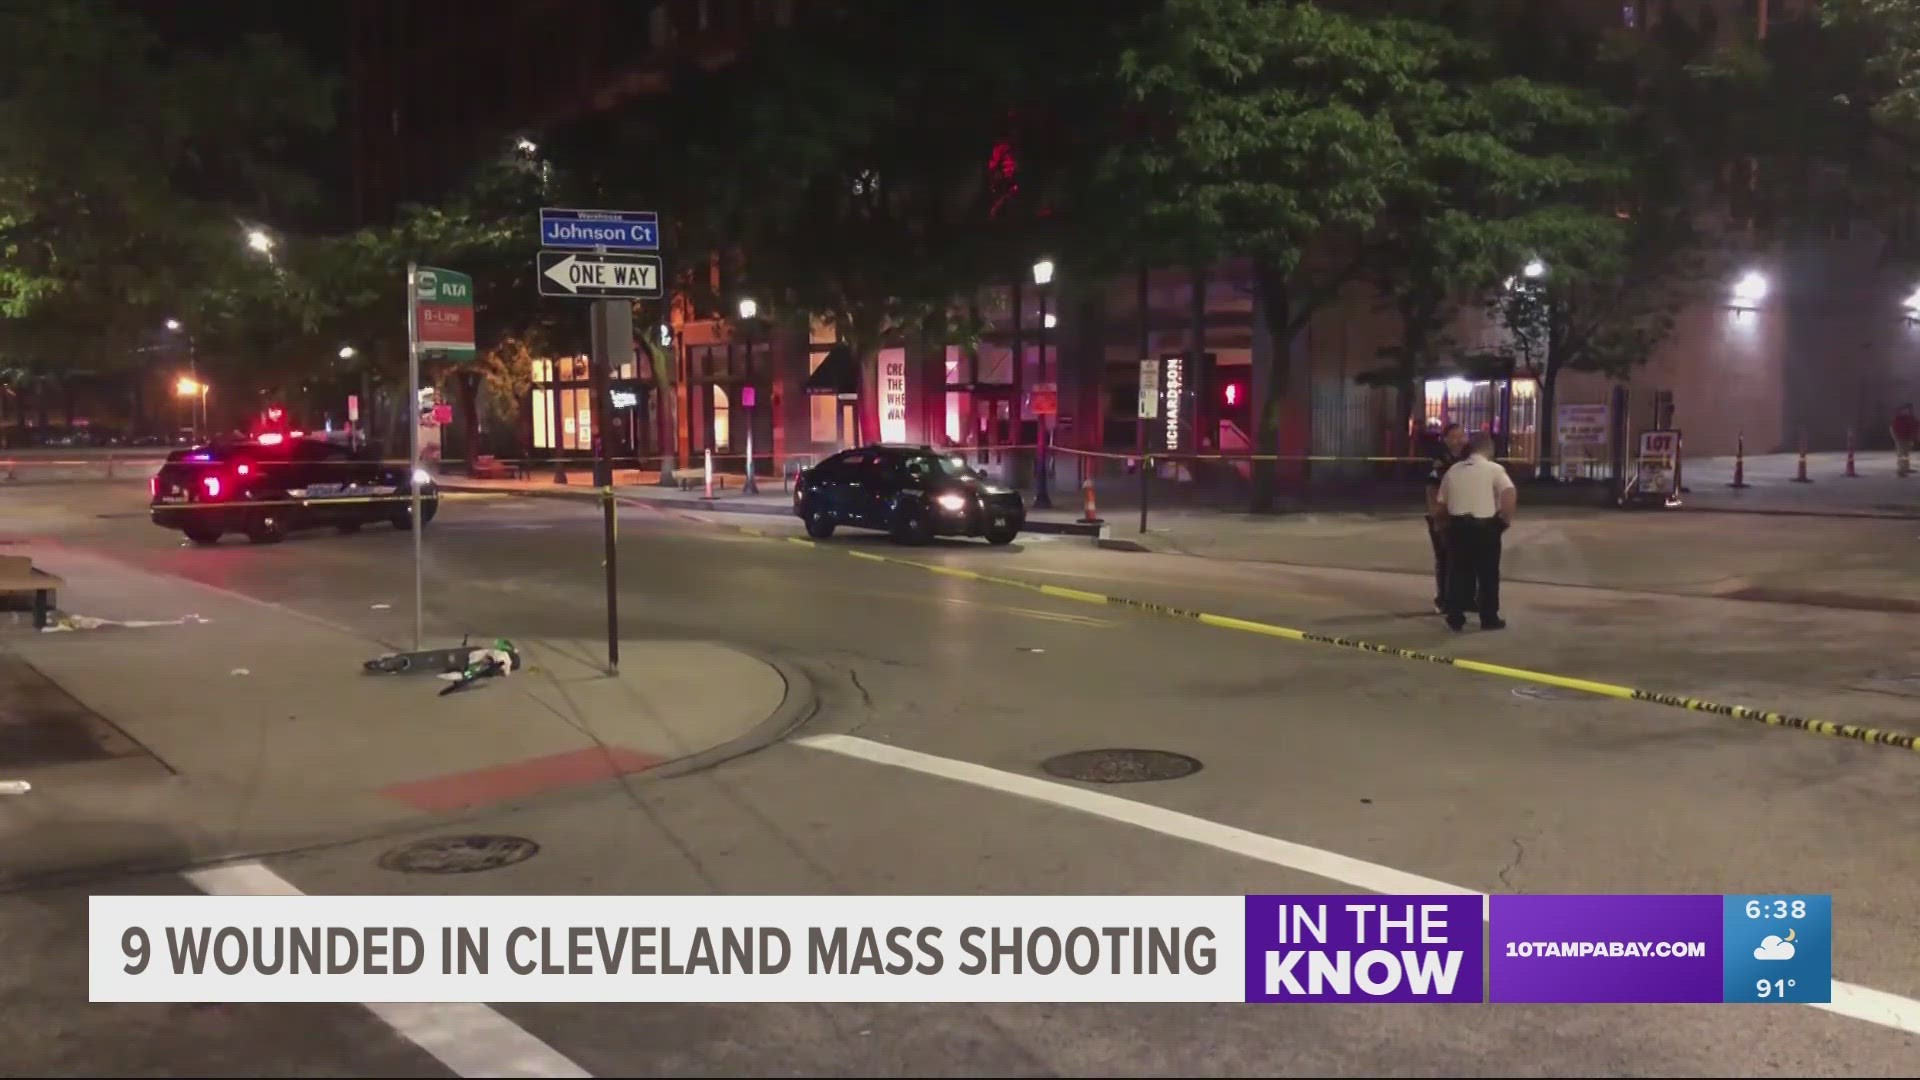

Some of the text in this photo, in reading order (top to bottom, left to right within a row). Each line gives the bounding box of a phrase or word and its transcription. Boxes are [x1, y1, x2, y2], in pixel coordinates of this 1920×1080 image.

[548, 222, 652, 242] Johnson Ct
[569, 263, 649, 286] ONE WAY
[887, 378, 904, 391] THE
[1647, 435, 1671, 452] LOT
